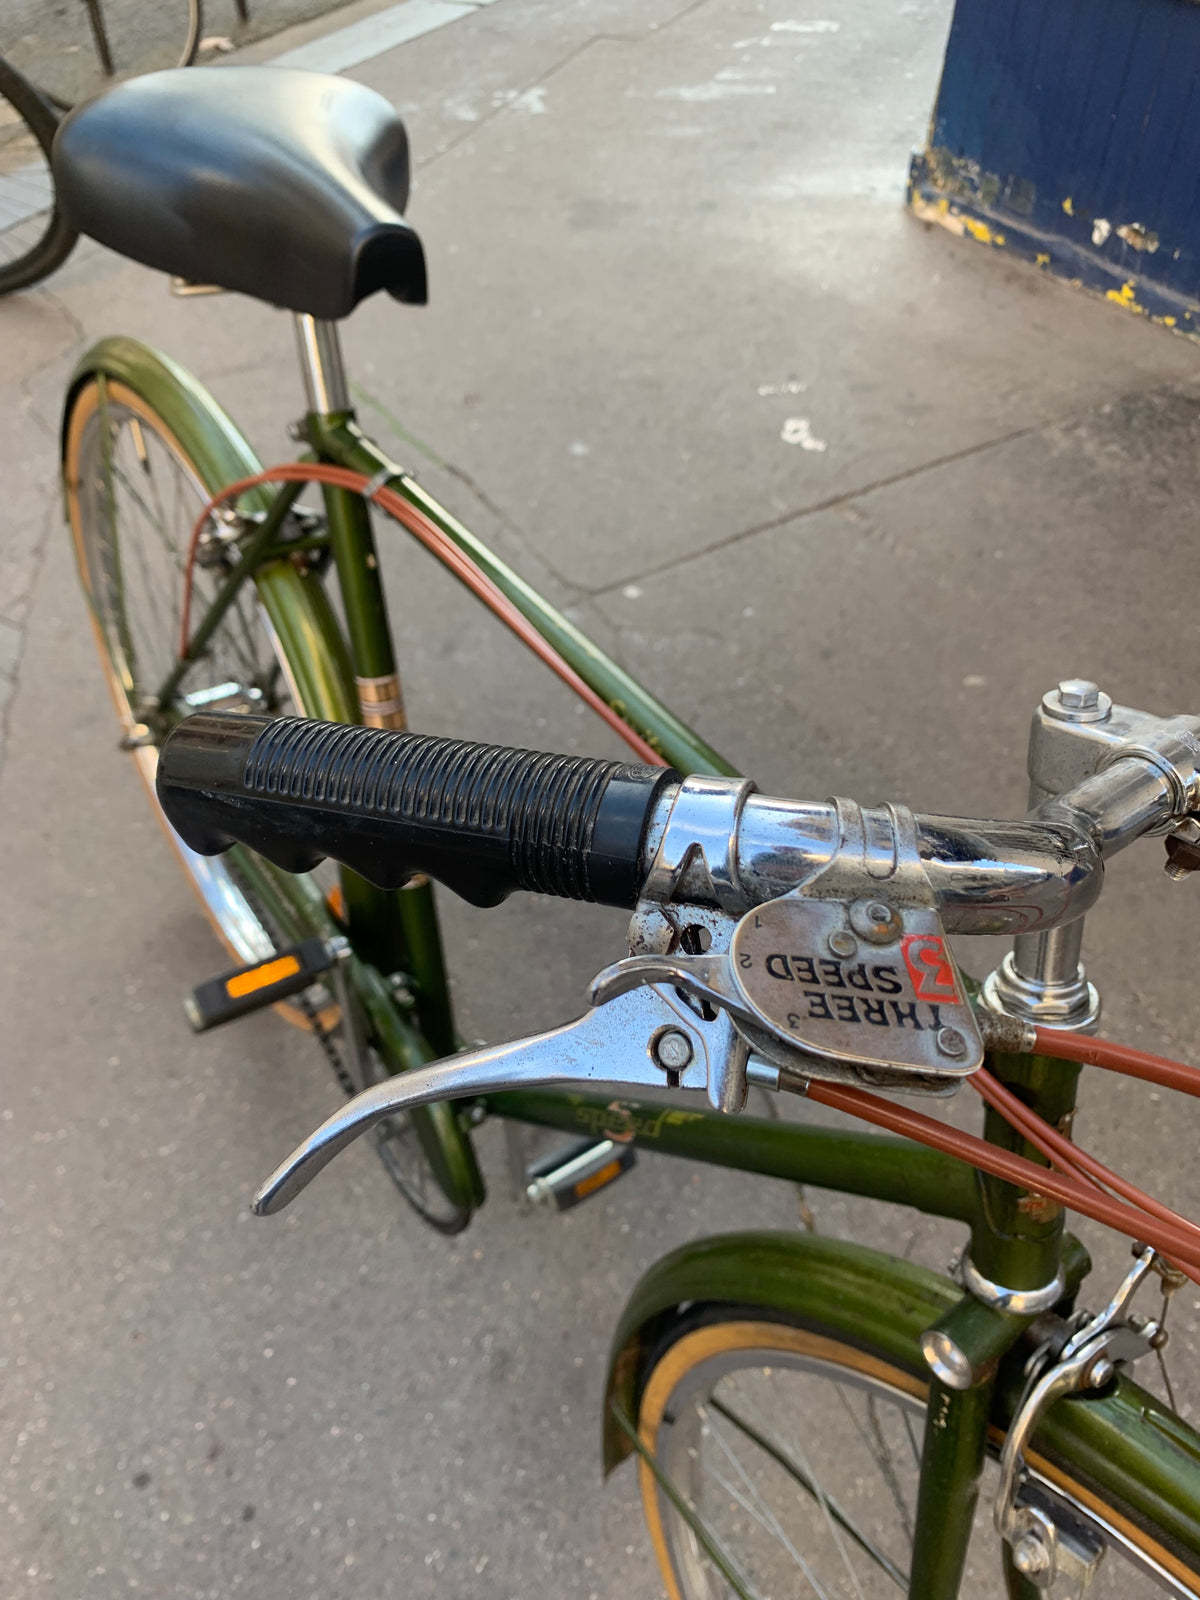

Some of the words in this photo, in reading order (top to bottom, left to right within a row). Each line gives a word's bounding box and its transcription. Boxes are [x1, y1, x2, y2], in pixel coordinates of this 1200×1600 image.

[755, 915, 763, 929] 1
[740, 954, 753, 969] 2
[766, 954, 903, 993] SPEED
[908, 939, 954, 995] 3
[787, 1013, 800, 1029] 3
[804, 991, 943, 1031] THREE
